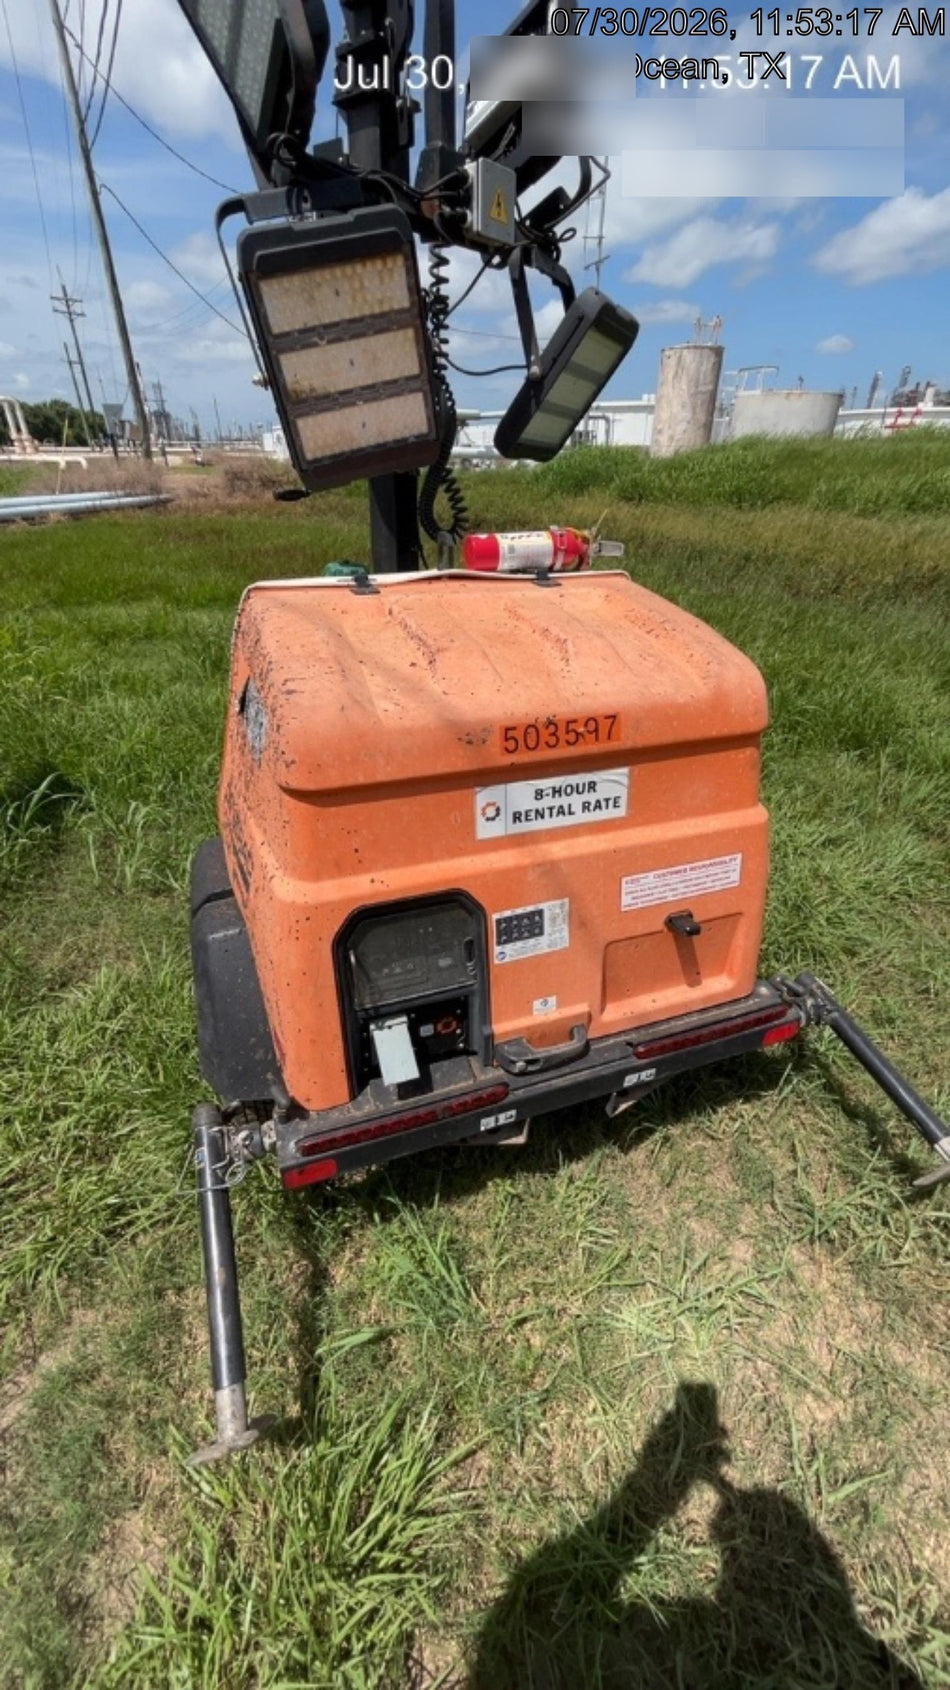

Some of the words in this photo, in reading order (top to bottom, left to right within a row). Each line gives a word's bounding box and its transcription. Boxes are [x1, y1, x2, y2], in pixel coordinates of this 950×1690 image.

[503, 714, 618, 754] 503597
[534, 780, 598, 801] 8-HOUR
[512, 803, 576, 824] RENTAL
[581, 795, 622, 814] RATE
